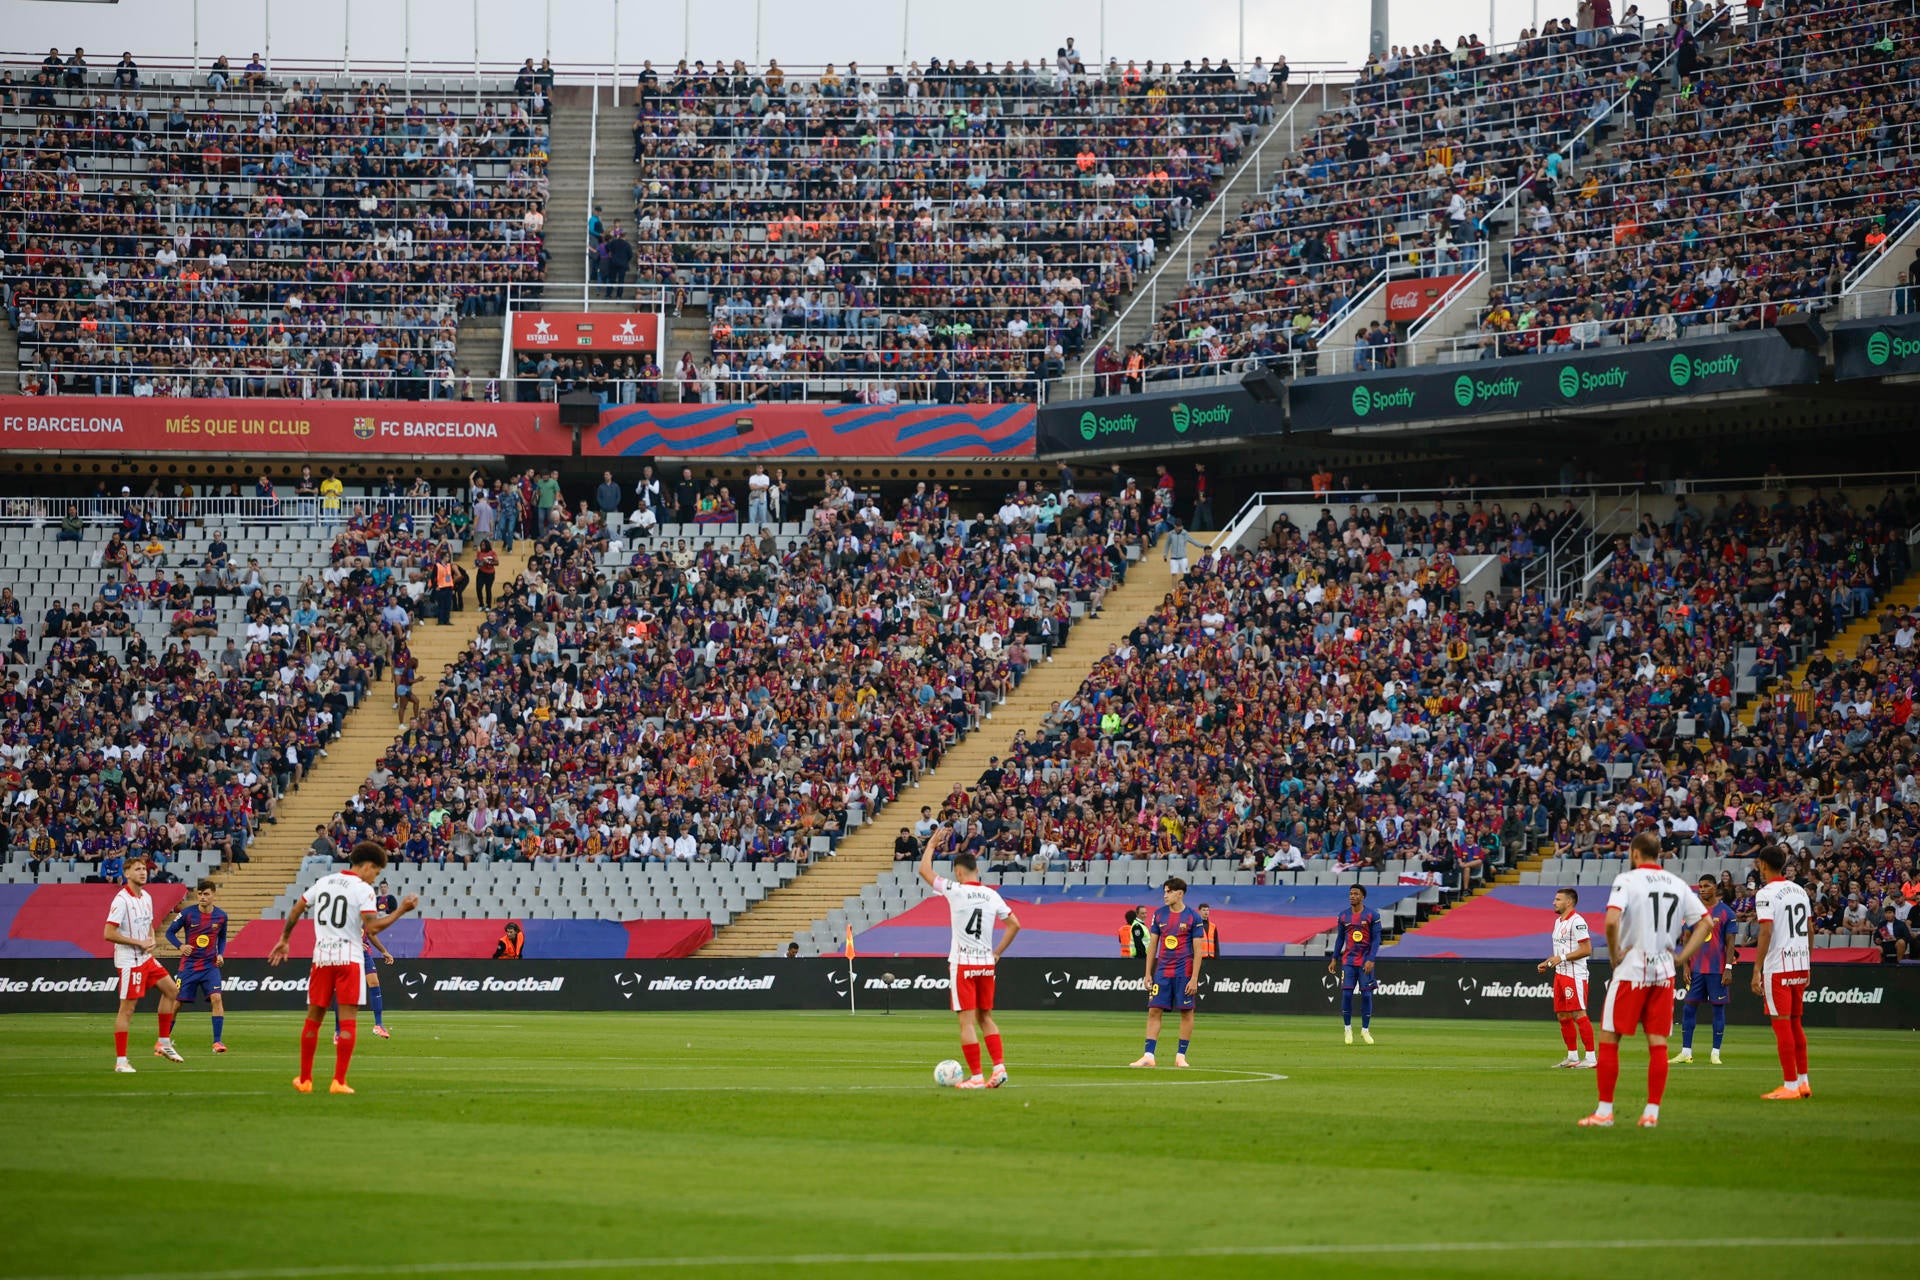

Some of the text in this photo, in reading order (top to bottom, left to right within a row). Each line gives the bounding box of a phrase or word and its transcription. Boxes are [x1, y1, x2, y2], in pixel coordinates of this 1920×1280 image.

[526, 334, 558, 342] ESTRELLA
[612, 334, 644, 342] ESTRELLA
[1694, 354, 1740, 378] Spotify
[1582, 367, 1627, 391] Spotify
[1476, 377, 1520, 400] Spotify
[1373, 388, 1414, 411] Spotify
[1192, 405, 1231, 426] Spotify
[4, 417, 124, 432] FC BARCELONA
[166, 415, 310, 436] MÉS QUE UN CLUB
[381, 421, 498, 438] FC BARCELONA
[1099, 414, 1137, 435] Spotify
[318, 892, 348, 929] 20
[1648, 892, 1679, 933] 17
[965, 908, 982, 940] 4
[1784, 903, 1808, 938] 12
[30, 976, 120, 992] football
[132, 972, 142, 985] 19
[434, 976, 564, 992] nike football
[648, 976, 776, 990] nike football
[912, 975, 951, 989] foo
[1075, 976, 1112, 990] nike
[1214, 978, 1291, 993] nike football
[1481, 982, 1512, 997] nike
[1819, 986, 1884, 1004] football
